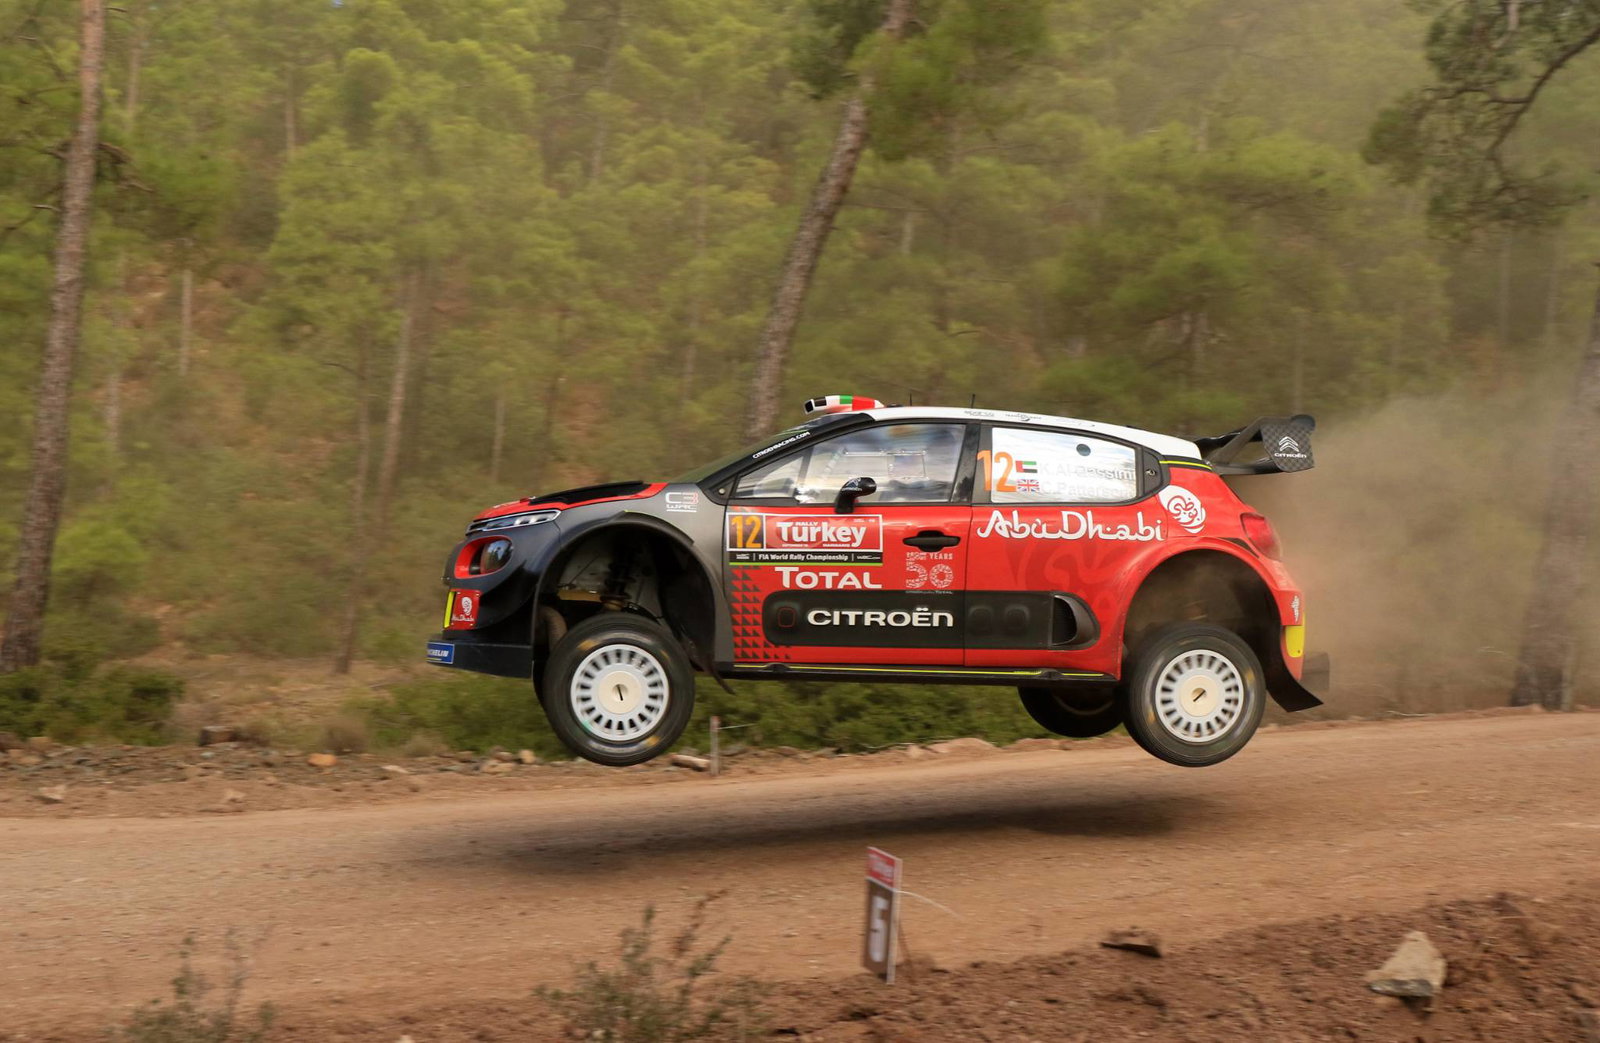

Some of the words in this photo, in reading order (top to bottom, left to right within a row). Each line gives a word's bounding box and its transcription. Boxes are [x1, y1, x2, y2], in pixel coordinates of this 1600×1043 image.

[977, 449, 1017, 492] 12
[731, 515, 762, 548] 12
[776, 521, 867, 547] Turkey
[977, 509, 1062, 539] Abu
[1060, 510, 1166, 542] Dhabi
[758, 553, 769, 561] FIA
[770, 553, 788, 561] World
[789, 553, 805, 562] Rally
[806, 553, 849, 562] Championship
[930, 552, 954, 560] YEARS
[774, 566, 882, 589] TOTAL
